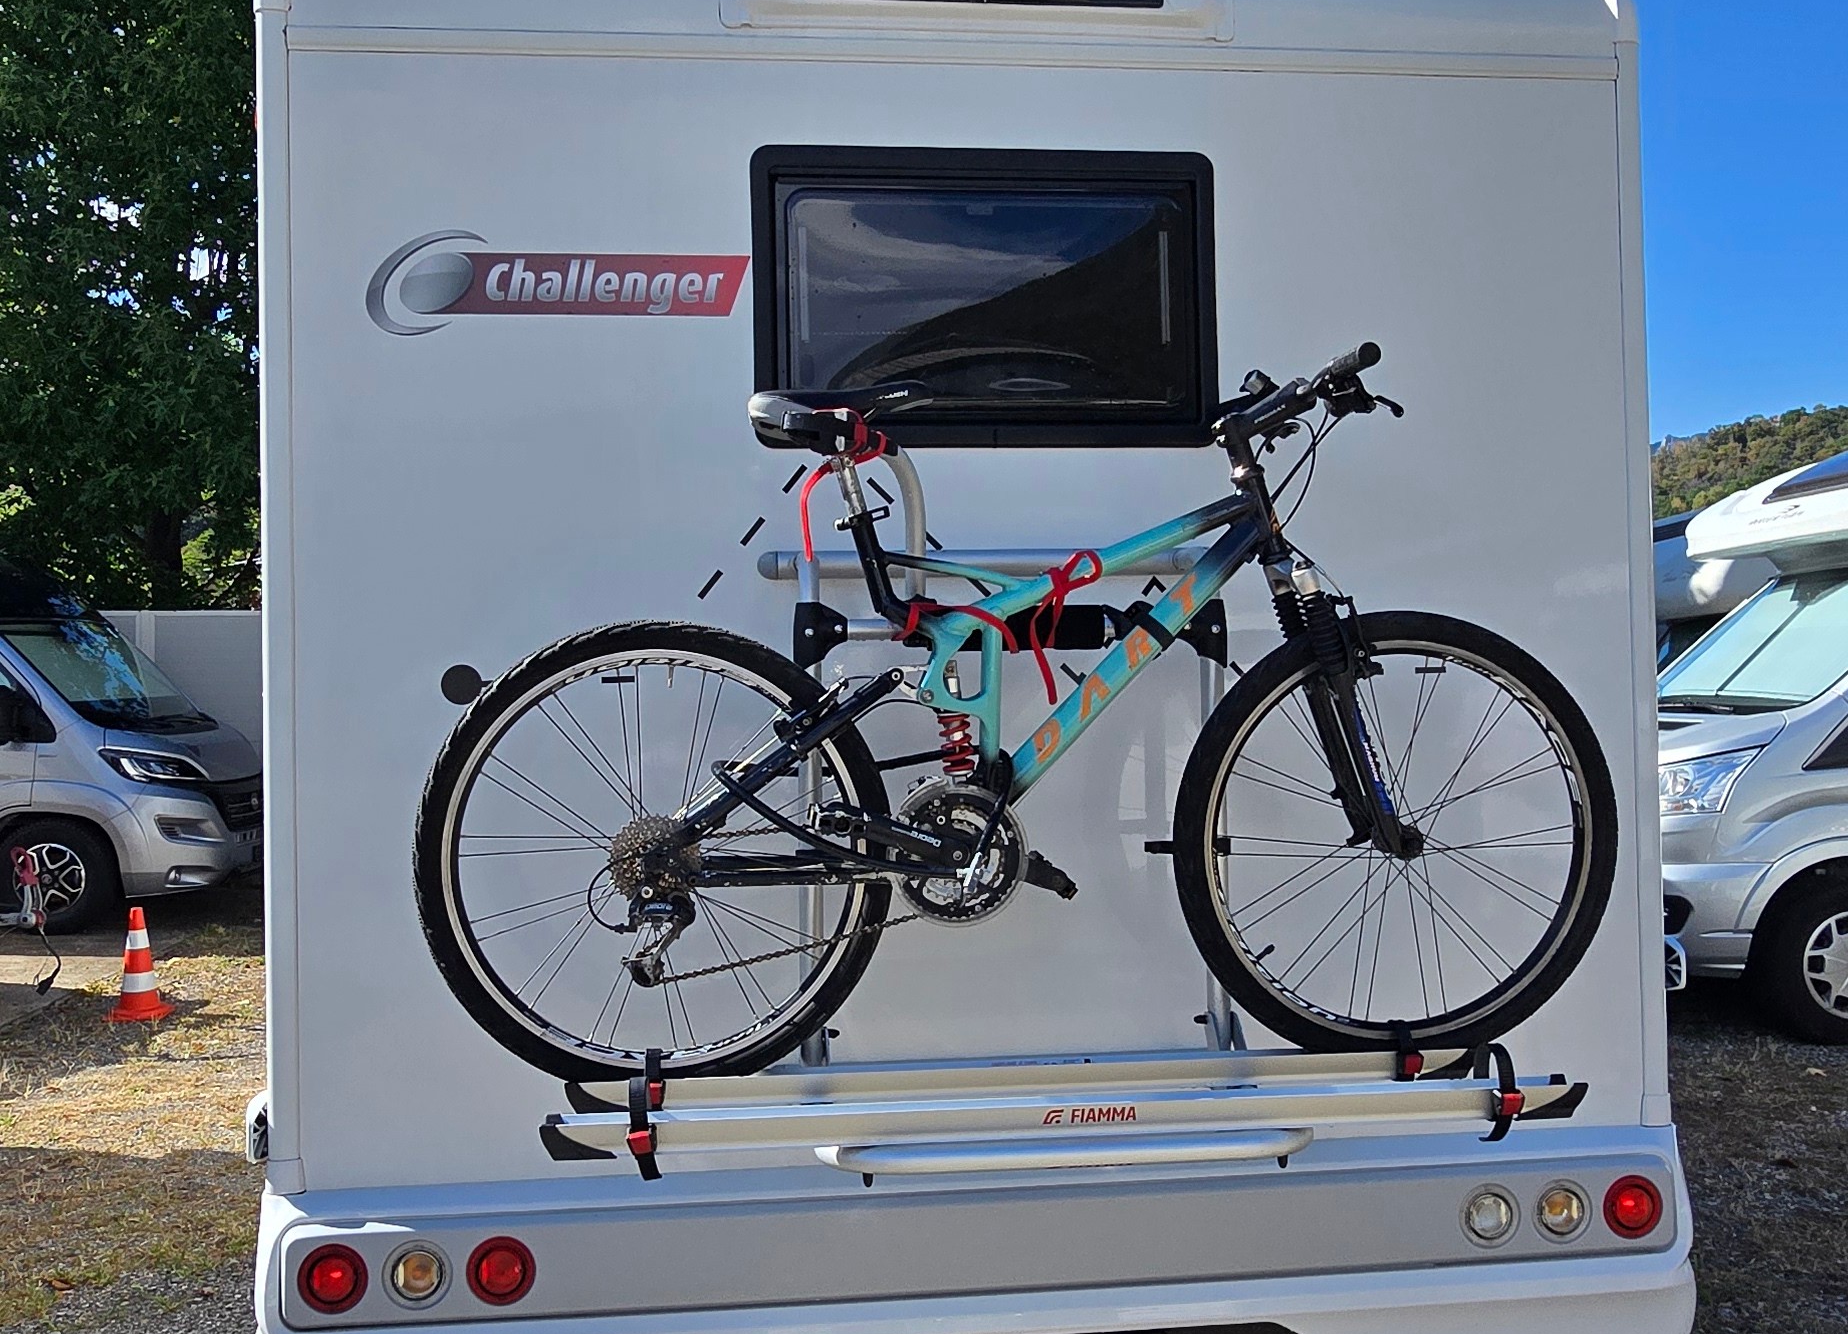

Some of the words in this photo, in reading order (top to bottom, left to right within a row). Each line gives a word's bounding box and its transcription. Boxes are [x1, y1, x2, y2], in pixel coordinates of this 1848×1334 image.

[485, 258, 724, 315] Challenger
[1031, 575, 1197, 765] DART
[1070, 1105, 1137, 1124] FIAMMA
